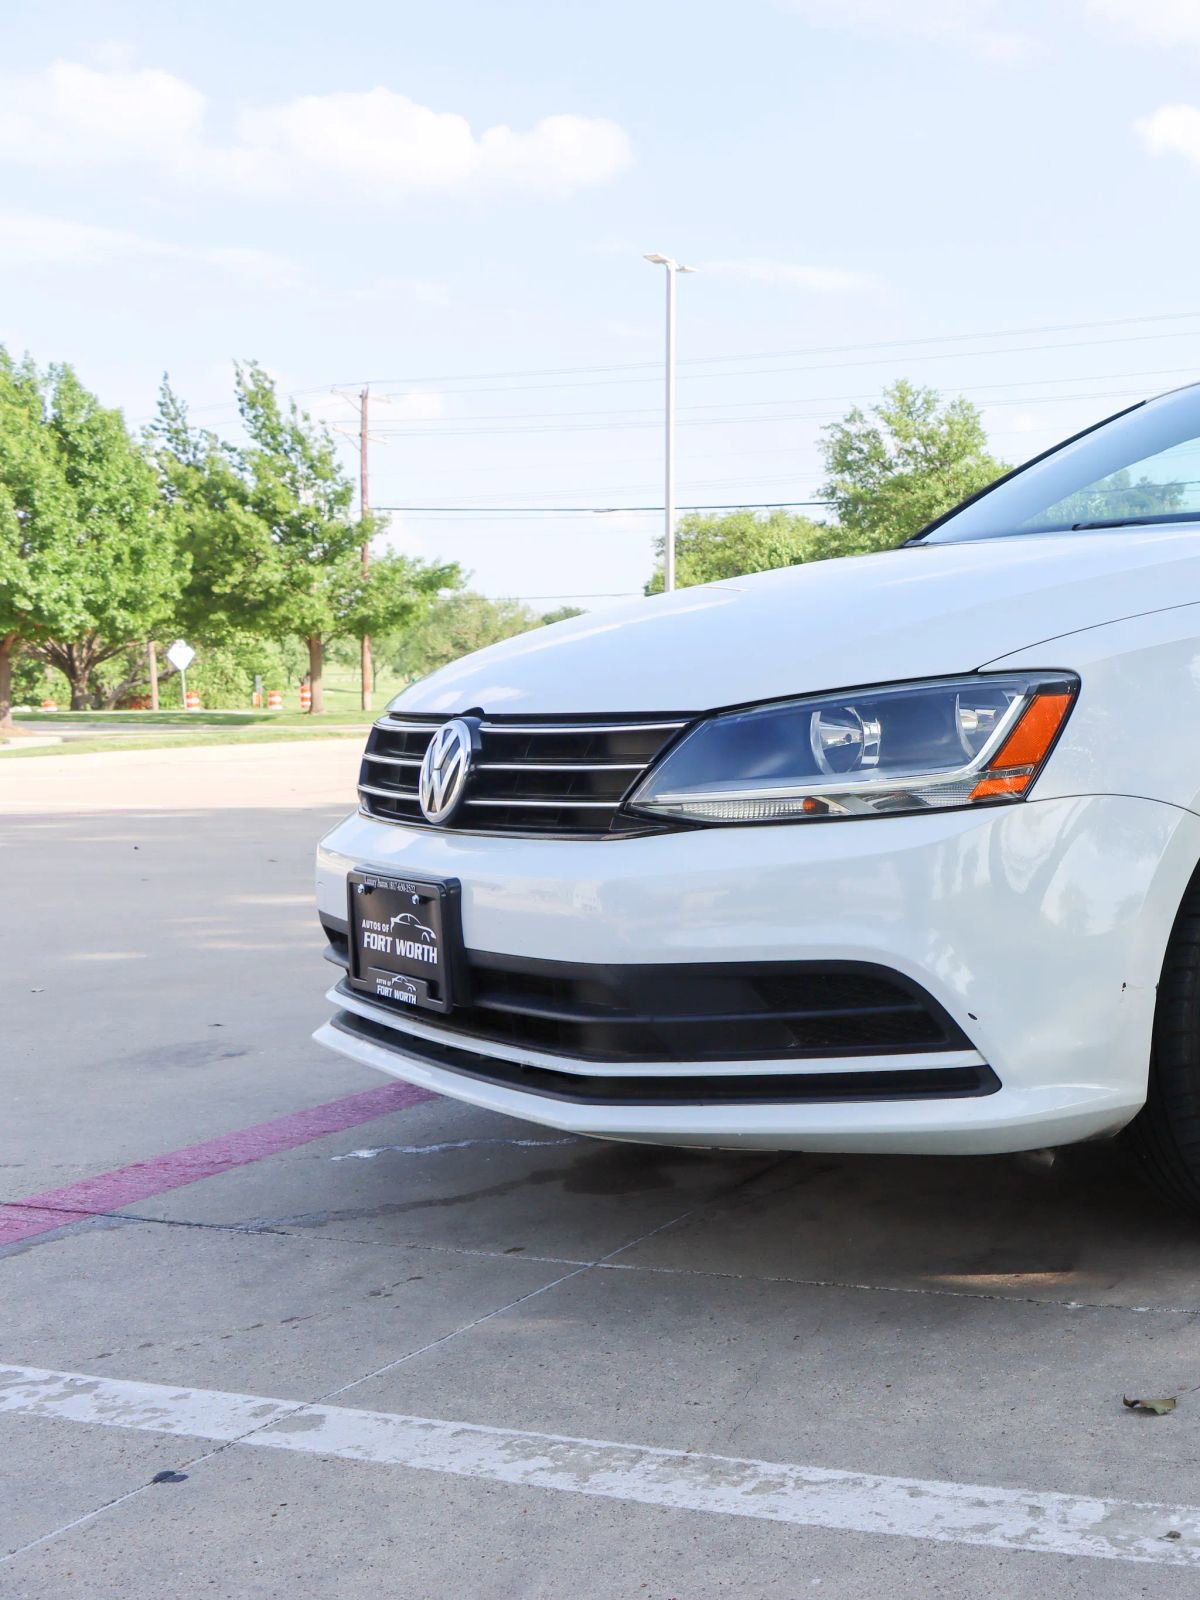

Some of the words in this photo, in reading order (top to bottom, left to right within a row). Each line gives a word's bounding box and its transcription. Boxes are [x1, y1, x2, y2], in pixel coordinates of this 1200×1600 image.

[361, 919, 381, 930] AUTOS
[381, 923, 390, 933] OF
[363, 932, 393, 953] FORT
[395, 938, 438, 964] WORTH
[376, 985, 393, 998] FORT
[394, 990, 417, 1004] WORTH
